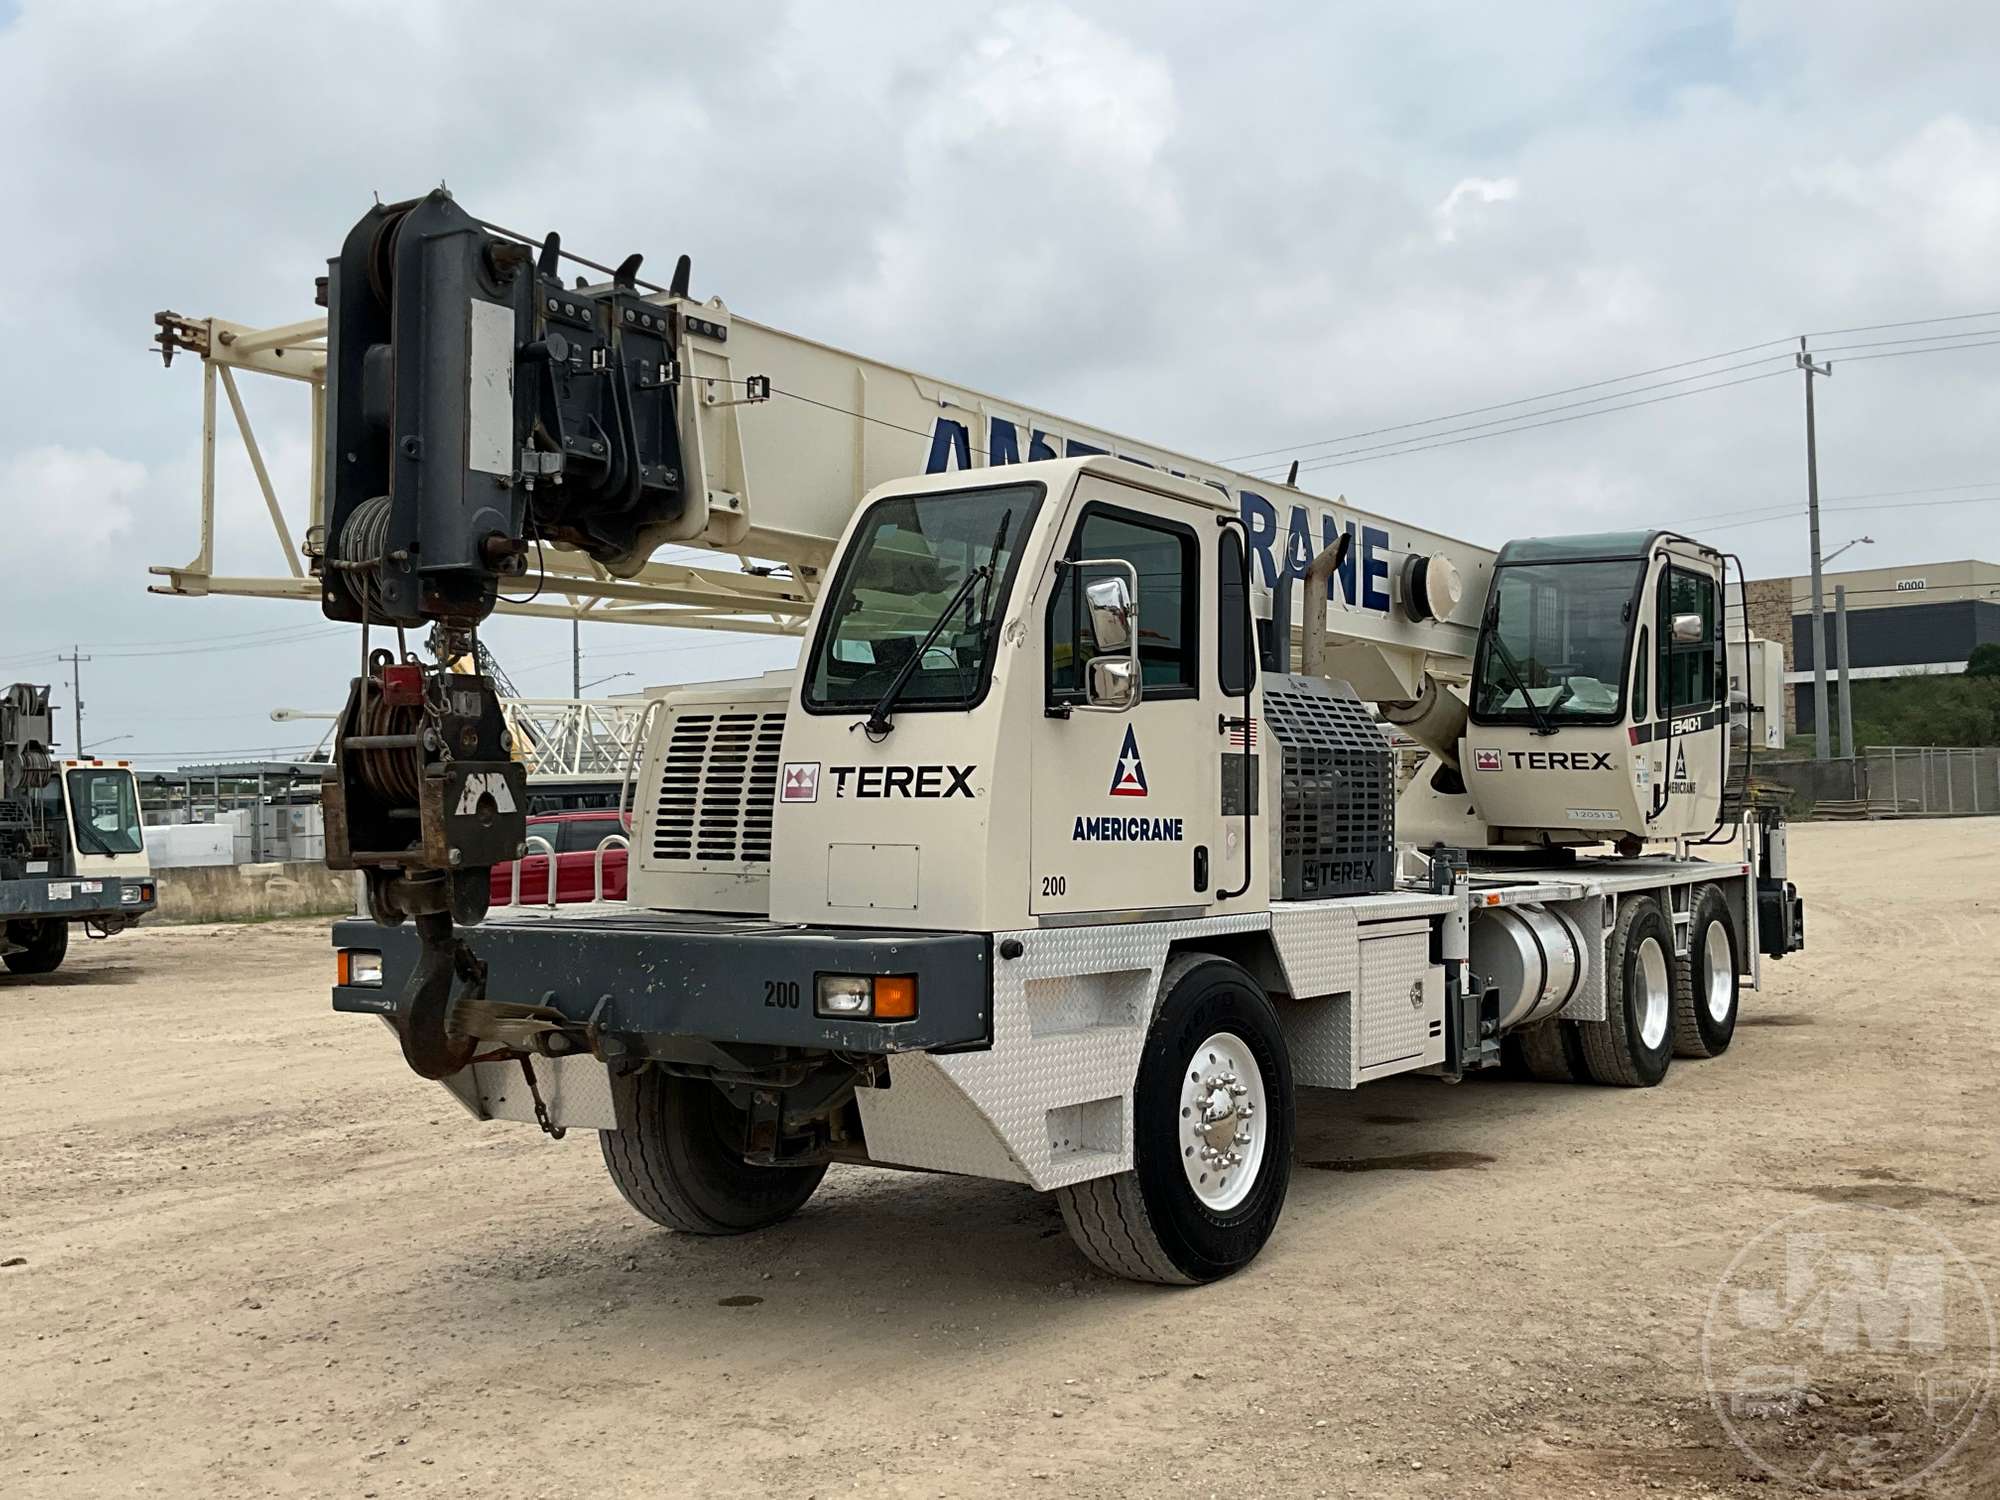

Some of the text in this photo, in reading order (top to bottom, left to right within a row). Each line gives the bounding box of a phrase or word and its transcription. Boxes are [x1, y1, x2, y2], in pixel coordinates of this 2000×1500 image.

[925, 415, 1391, 613] ARANE
[1897, 580, 1924, 591] 6000
[1507, 751, 1614, 770] TEREX
[829, 765, 977, 798] TEREX
[1668, 782, 1696, 794] MERICRANE
[1574, 810, 1614, 820] 120513
[1072, 816, 1183, 842] AMERICRANE
[1320, 859, 1376, 887] TEREX
[1042, 876, 1066, 896] 200
[764, 981, 800, 1008] 200
